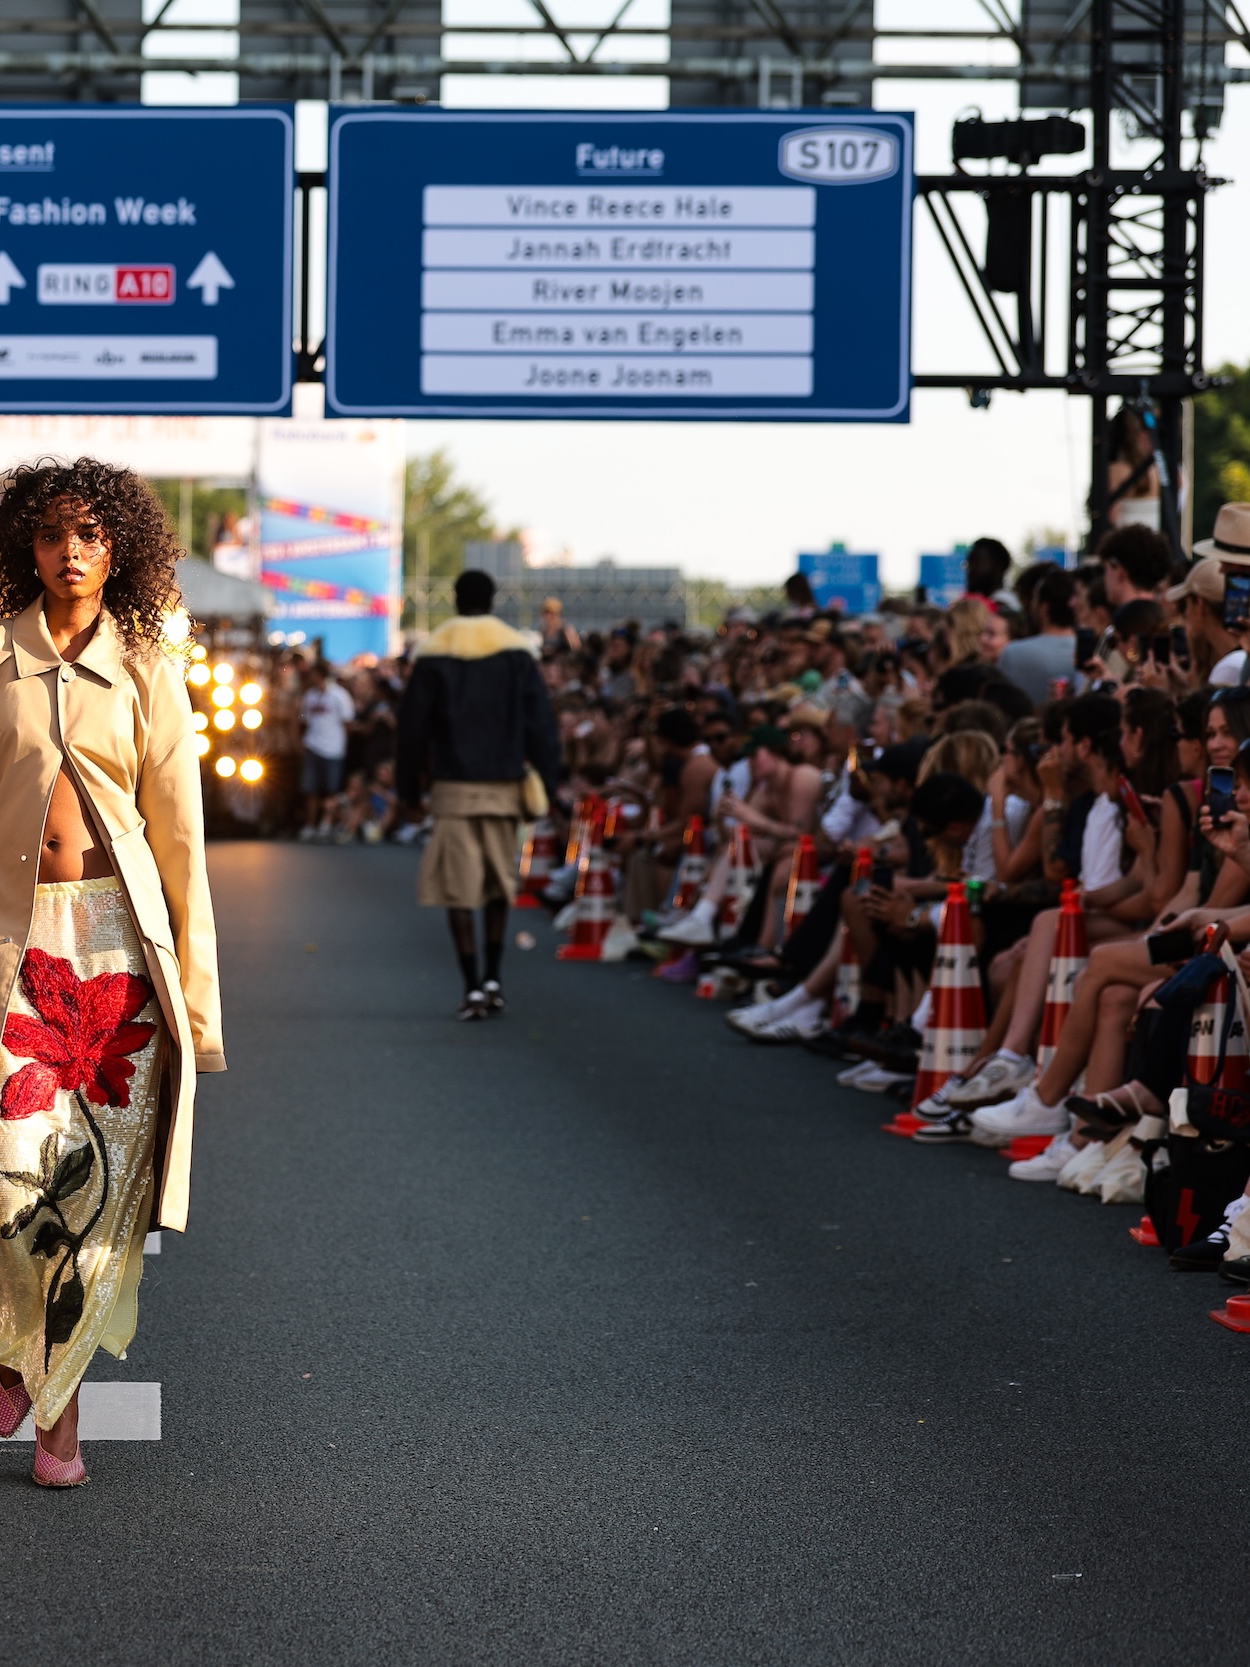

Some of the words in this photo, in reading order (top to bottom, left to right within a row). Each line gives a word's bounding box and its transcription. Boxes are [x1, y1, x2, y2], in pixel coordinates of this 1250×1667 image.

[576, 143, 665, 170] Future
[799, 140, 880, 169] S107
[114, 197, 196, 225] Week
[507, 197, 578, 218] Vince
[588, 195, 665, 217] Reece
[675, 198, 732, 218] Hale
[508, 239, 600, 260] Jannah
[610, 237, 731, 261] Erdtracht
[44, 273, 111, 295] RING
[120, 274, 169, 295] A10
[533, 279, 598, 301] River
[610, 282, 703, 307] Moojen
[492, 321, 575, 345] Emma
[584, 327, 628, 345] van
[638, 321, 743, 352] Engelen
[525, 365, 601, 387] Joone
[612, 366, 713, 387] Joonam
